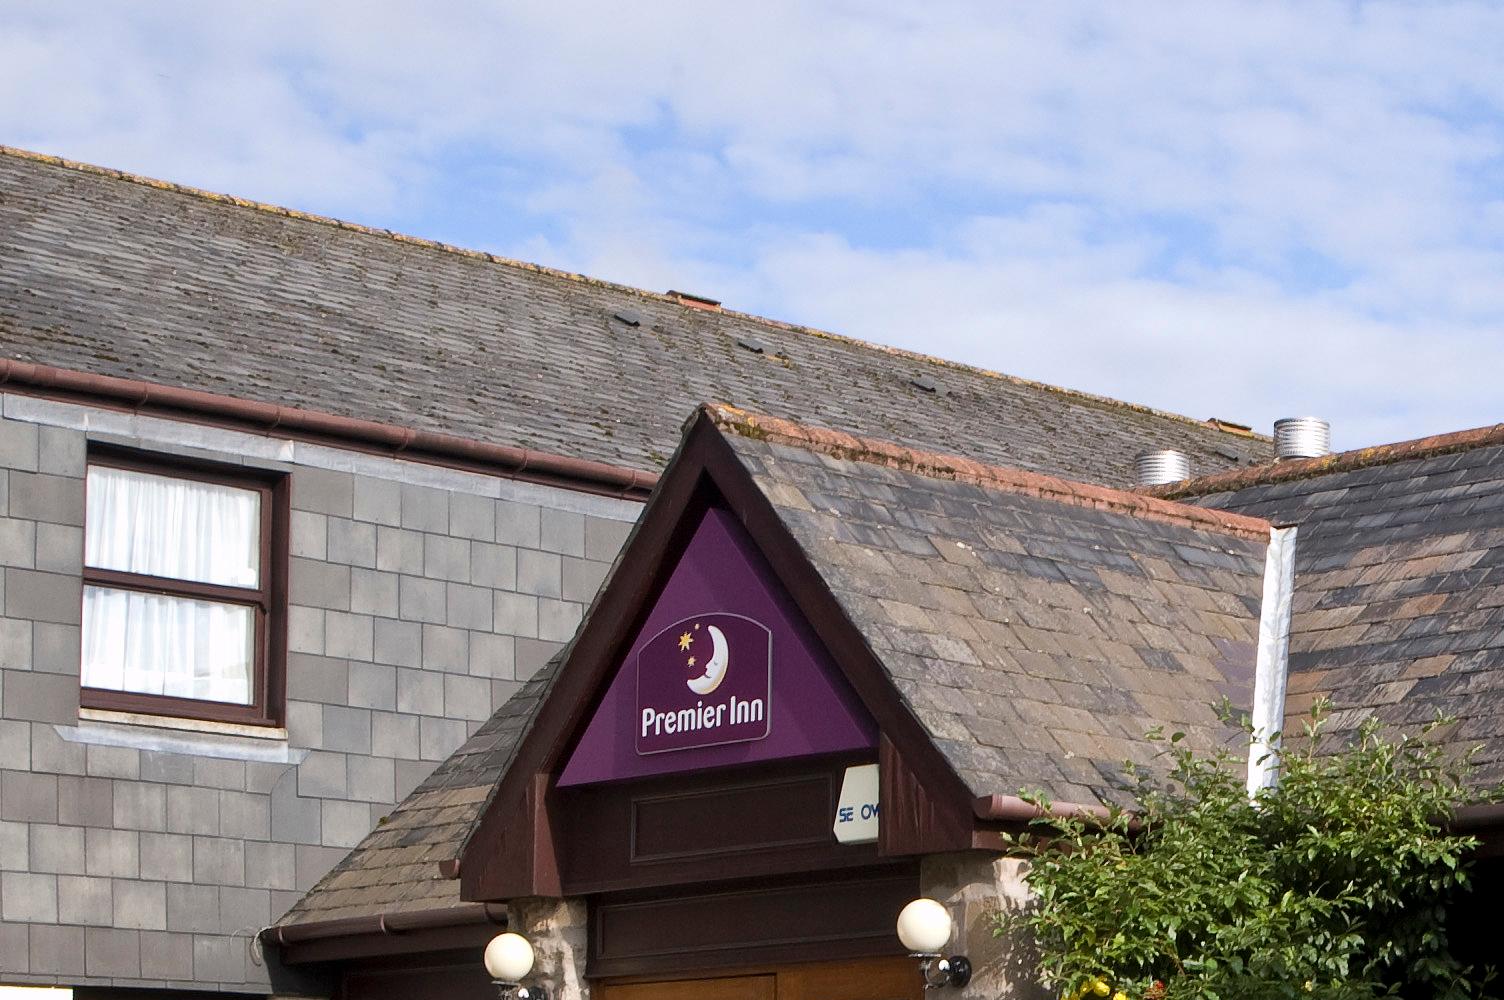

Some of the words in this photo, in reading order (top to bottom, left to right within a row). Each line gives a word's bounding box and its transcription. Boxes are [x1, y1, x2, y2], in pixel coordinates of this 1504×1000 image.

[642, 700, 727, 737] Premier
[729, 695, 763, 725] Inn
[839, 807, 854, 823] SE
